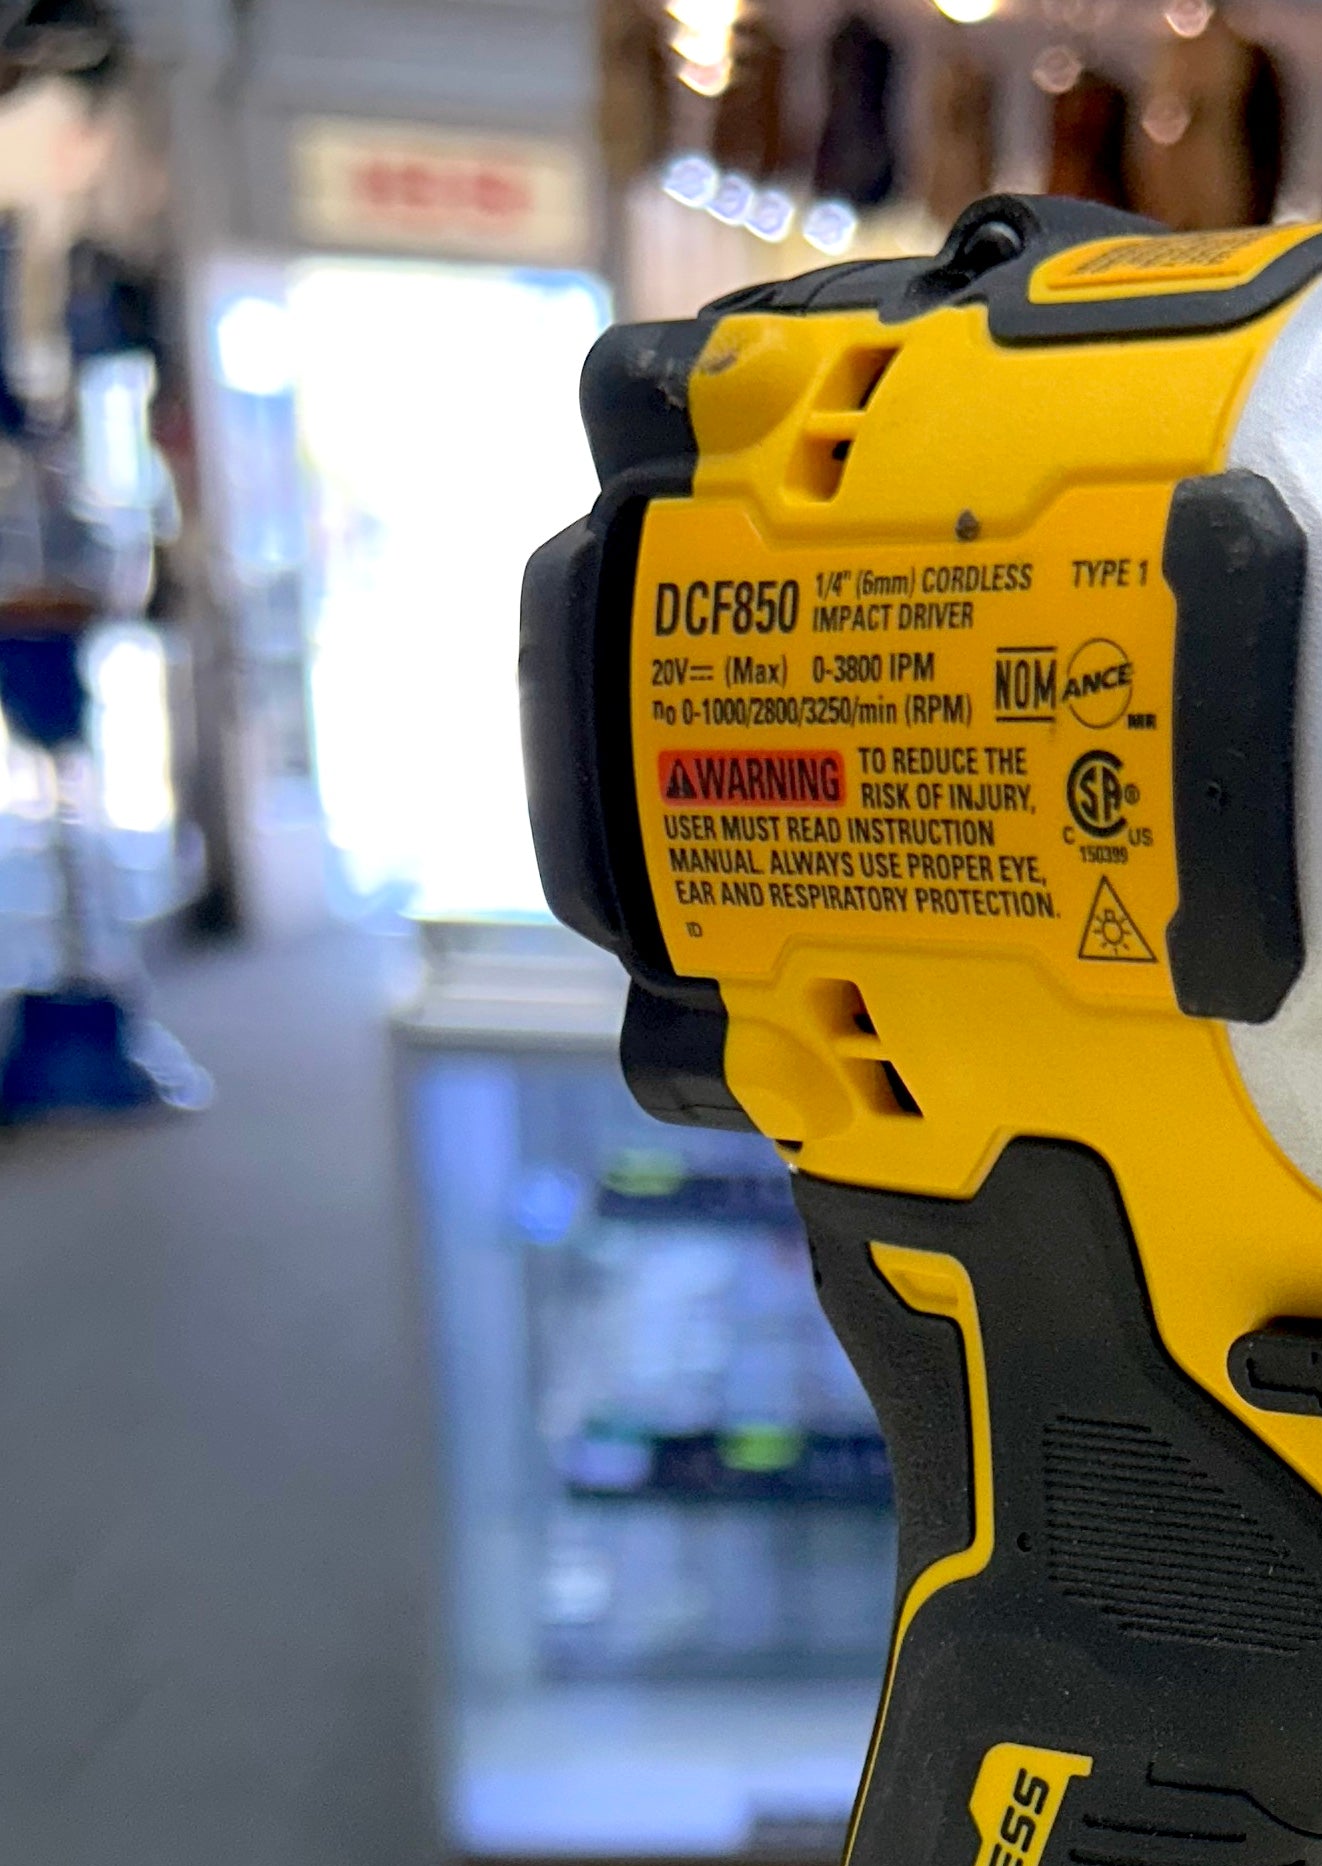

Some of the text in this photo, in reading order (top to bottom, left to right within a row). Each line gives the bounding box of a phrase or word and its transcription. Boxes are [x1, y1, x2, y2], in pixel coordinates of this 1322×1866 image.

[856, 566, 916, 599] (6mm)
[922, 563, 1033, 593] CORDLESS
[1072, 559, 1149, 588] TYPE 1
[655, 579, 800, 637] DCF850
[812, 601, 974, 632] IMPACT DRIVER
[725, 654, 788, 689] (Max)
[812, 652, 936, 683] 0-3800 IPM
[996, 658, 1057, 711] NOM
[1062, 662, 1133, 702] ANCE
[904, 693, 973, 728] (RPM)
[856, 747, 1028, 777] TO REDUCE THE
[693, 757, 841, 803] WARNING
[861, 782, 1037, 815] RISK OF INJURY,
[663, 814, 996, 847] USER MUST READ INSTRUCTION
[769, 849, 854, 878] ALWAYS
[859, 852, 902, 880] USE
[906, 852, 993, 882] PROPER
[998, 855, 1047, 887] EYE,
[675, 880, 1062, 919] EAR AND RESPIRATORY PROTECTION.
